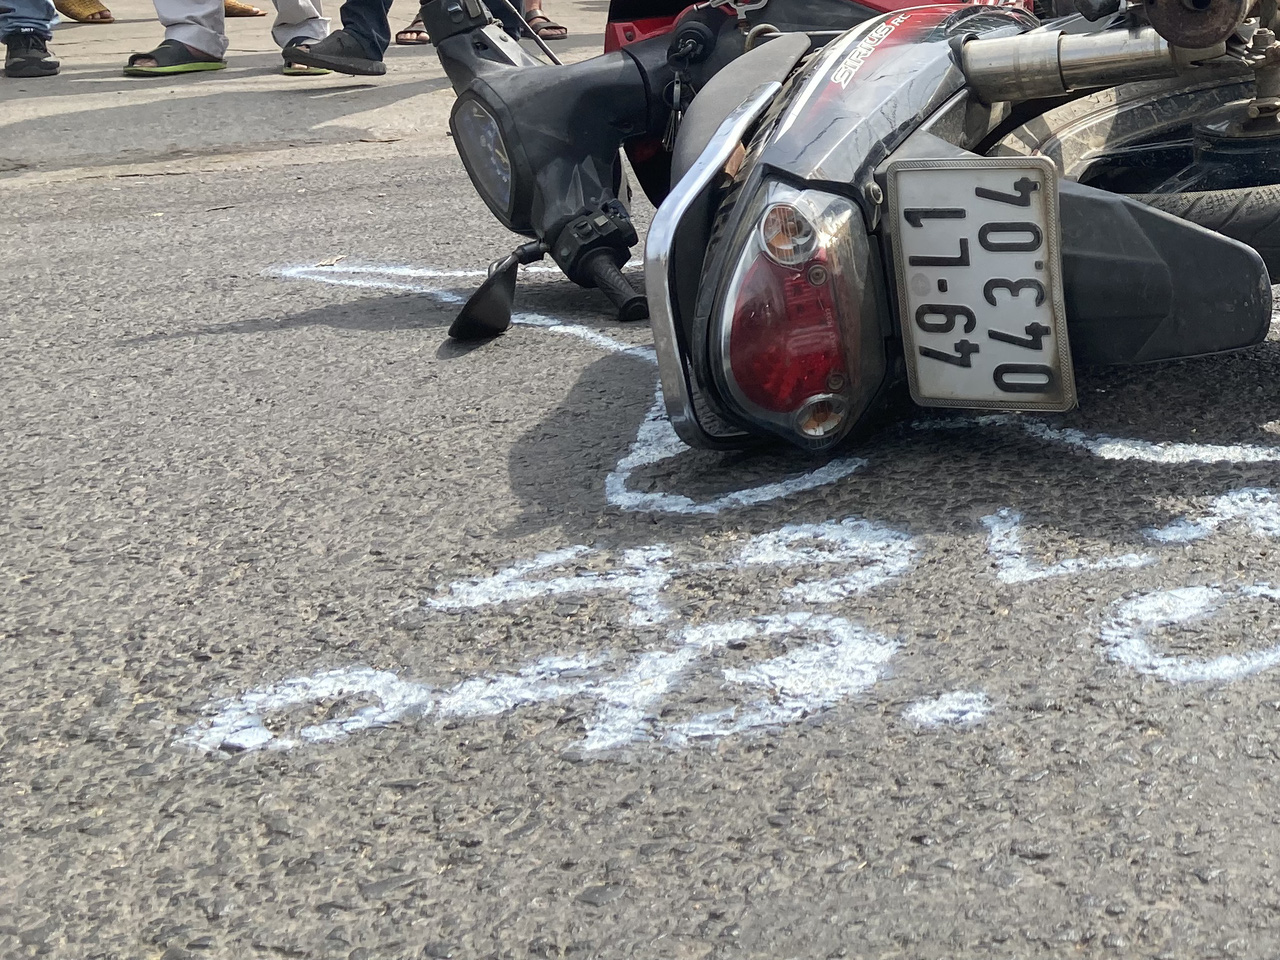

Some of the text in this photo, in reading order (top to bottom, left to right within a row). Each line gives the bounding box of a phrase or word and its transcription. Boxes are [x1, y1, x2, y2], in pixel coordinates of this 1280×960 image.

[830, 13, 912, 90] SIRIUS RC
[903, 207, 980, 368] 49-L1
[975, 176, 1055, 393] 043.04
